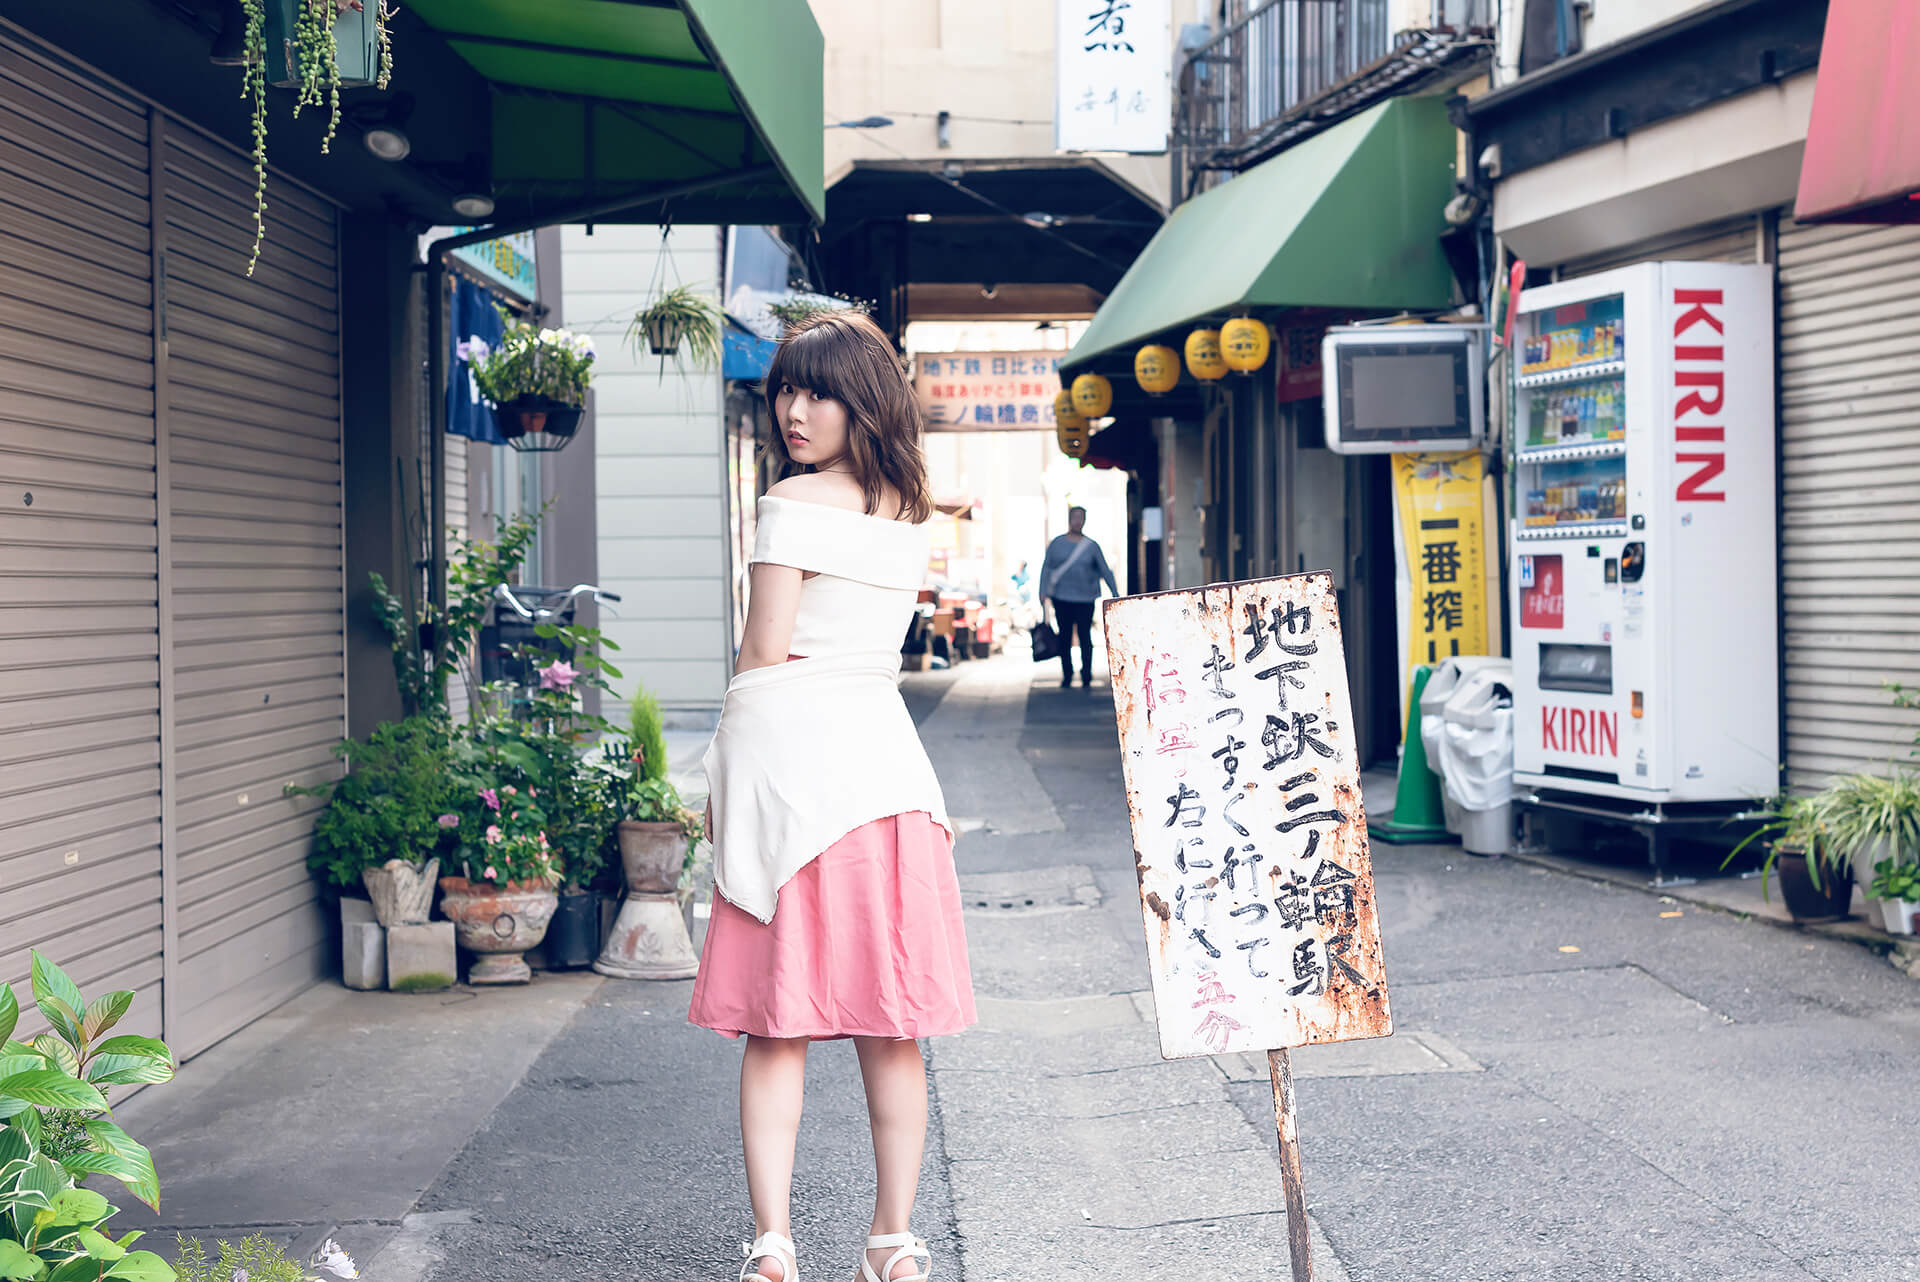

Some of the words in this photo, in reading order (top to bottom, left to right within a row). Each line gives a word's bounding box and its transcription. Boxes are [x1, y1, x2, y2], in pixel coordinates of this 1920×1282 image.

[1674, 289, 1726, 502] KIRIN
[1245, 601, 1366, 996] 地下鉄三ノ輪駅
[1542, 705, 1618, 758] KIRIN
